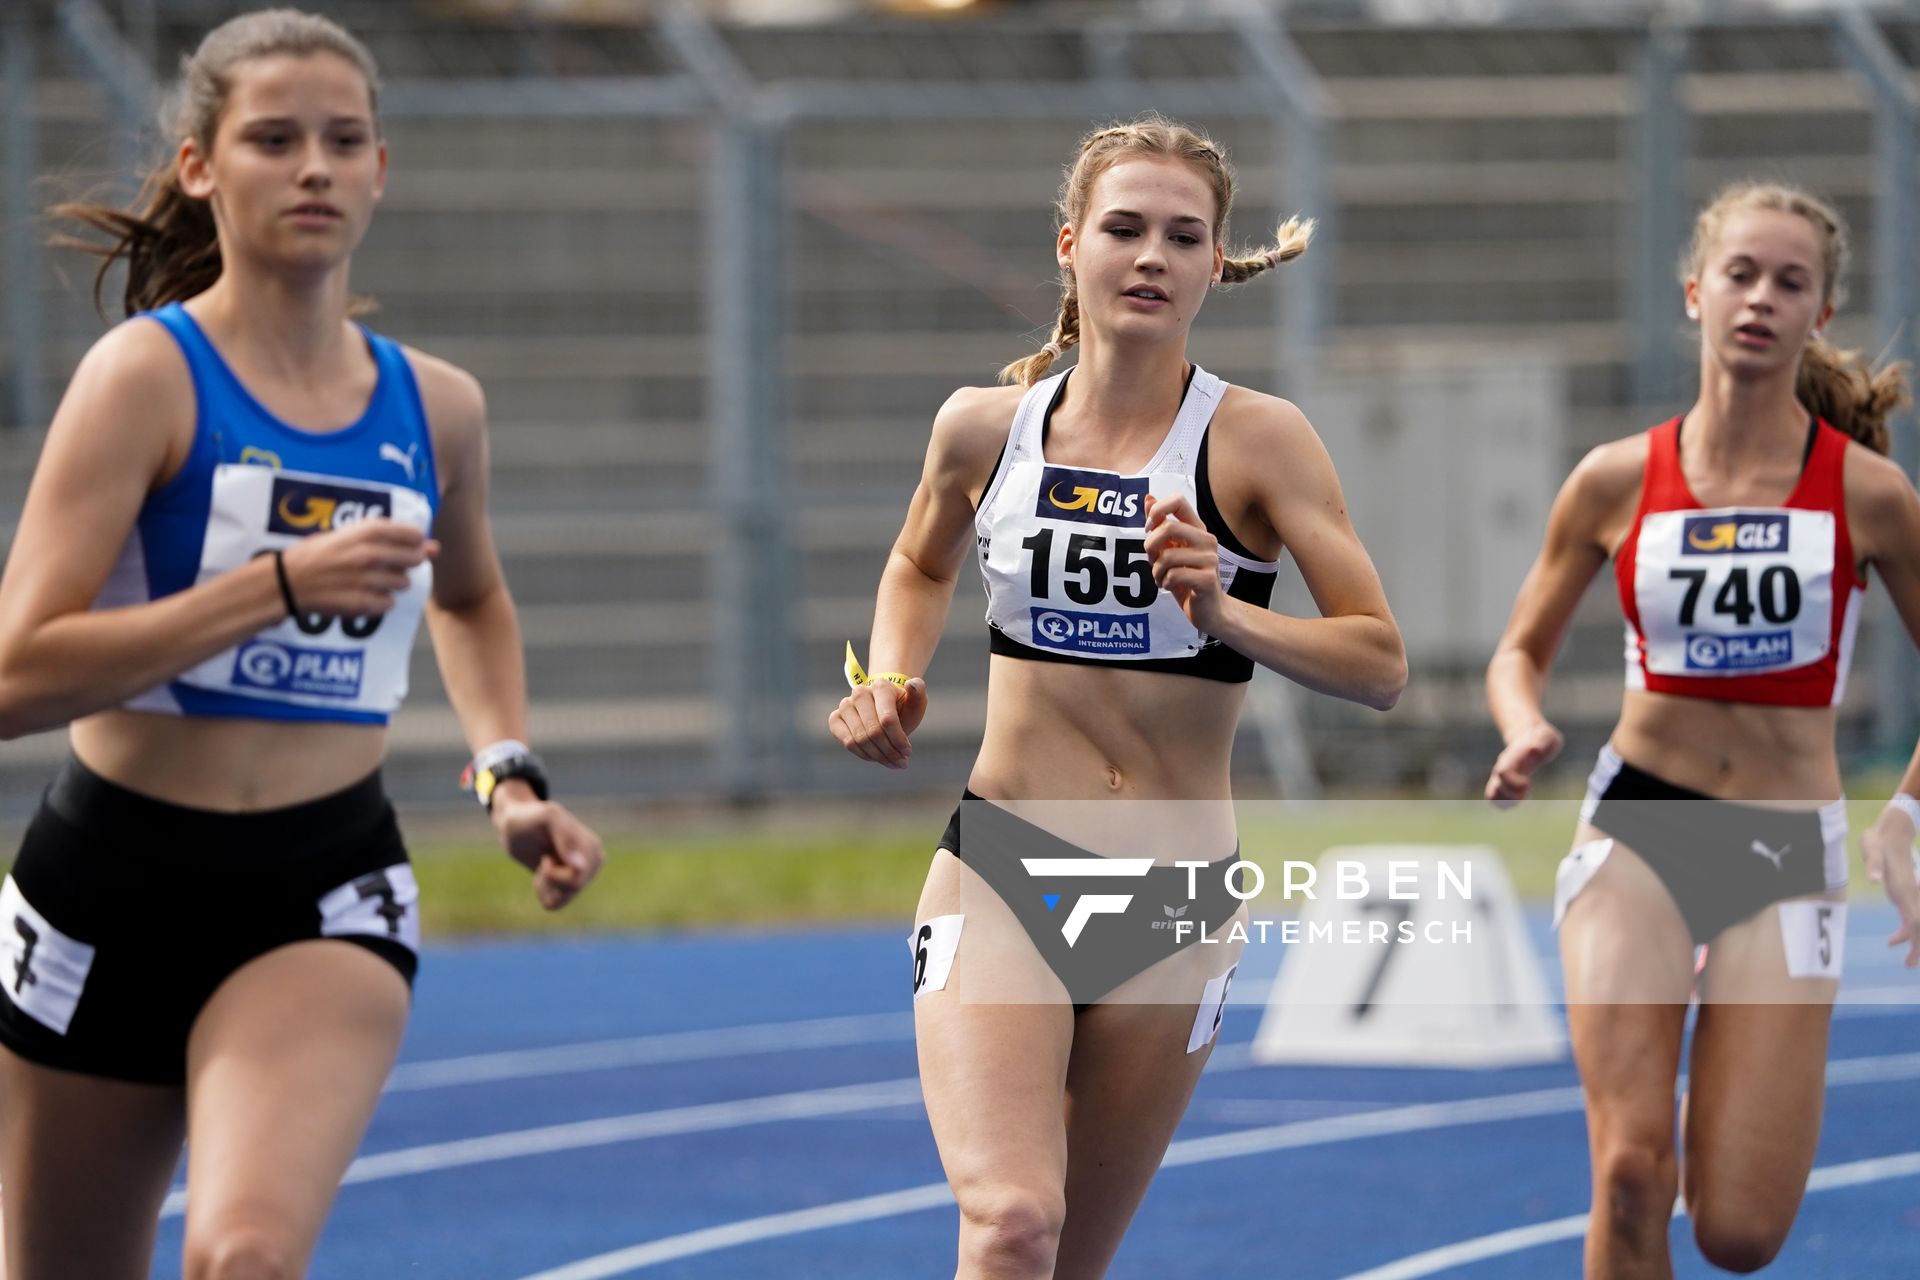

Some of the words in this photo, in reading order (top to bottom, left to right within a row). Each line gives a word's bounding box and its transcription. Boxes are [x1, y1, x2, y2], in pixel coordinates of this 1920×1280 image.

[1097, 490, 1138, 518] GLS
[1735, 521, 1782, 550] GLS
[1021, 528, 1159, 609] 155
[1667, 565, 1802, 627] 740
[1077, 619, 1145, 640] PLAN
[1078, 639, 1145, 649] INTERNATIONAL
[1726, 635, 1788, 657] PLAN
[293, 652, 361, 681] PLAN
[1816, 907, 1833, 968] 5
[13, 914, 39, 995] 7
[1349, 897, 1414, 1022] 7
